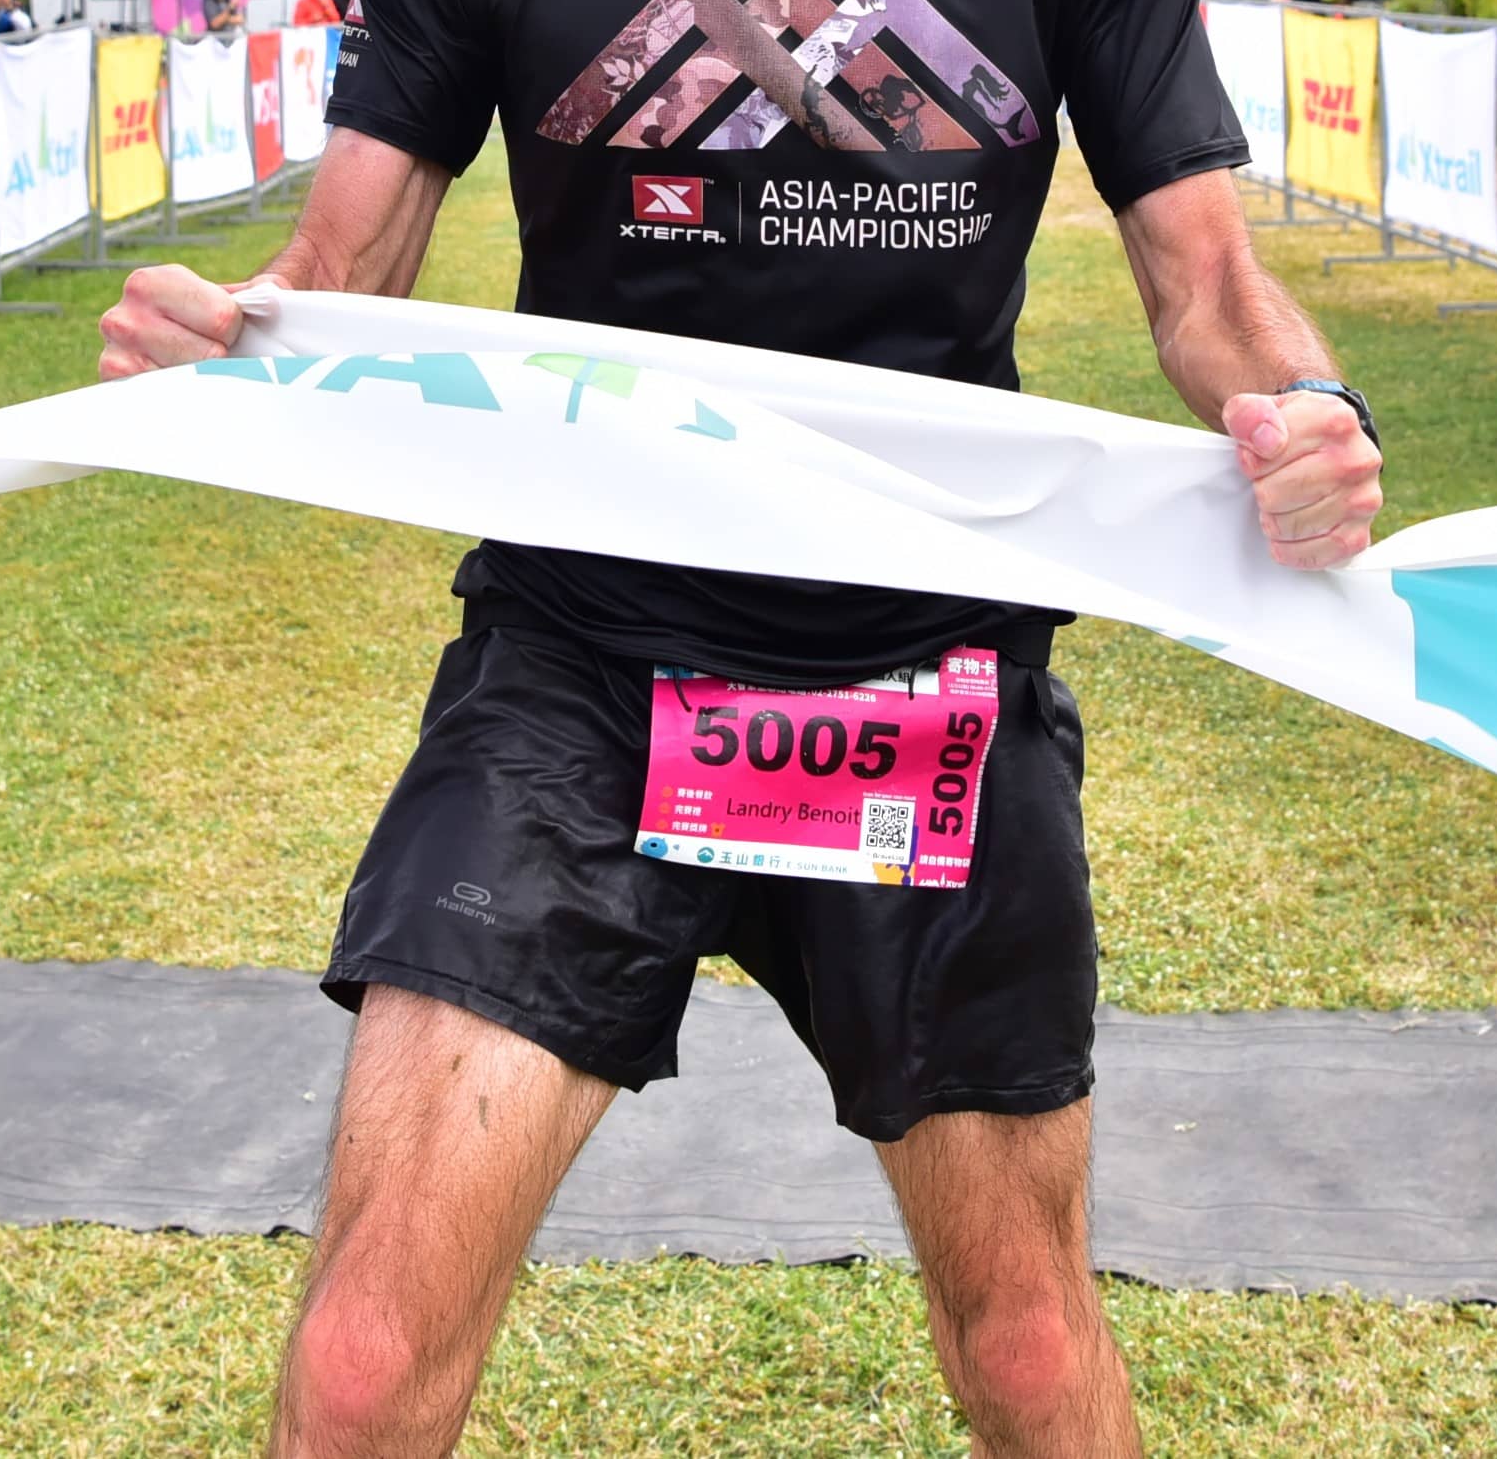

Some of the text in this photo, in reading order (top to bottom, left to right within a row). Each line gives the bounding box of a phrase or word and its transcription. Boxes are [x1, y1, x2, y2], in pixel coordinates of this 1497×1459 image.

[760, 180, 978, 213] ASIA-PACIFIC
[759, 213, 992, 249] CHAMPIONSHIP
[690, 706, 901, 780] 5005
[929, 712, 983, 837] 5005
[726, 798, 861, 825] Landry Benoit
[719, 851, 781, 869] 玉山銀行
[821, 865, 848, 874] BANK
